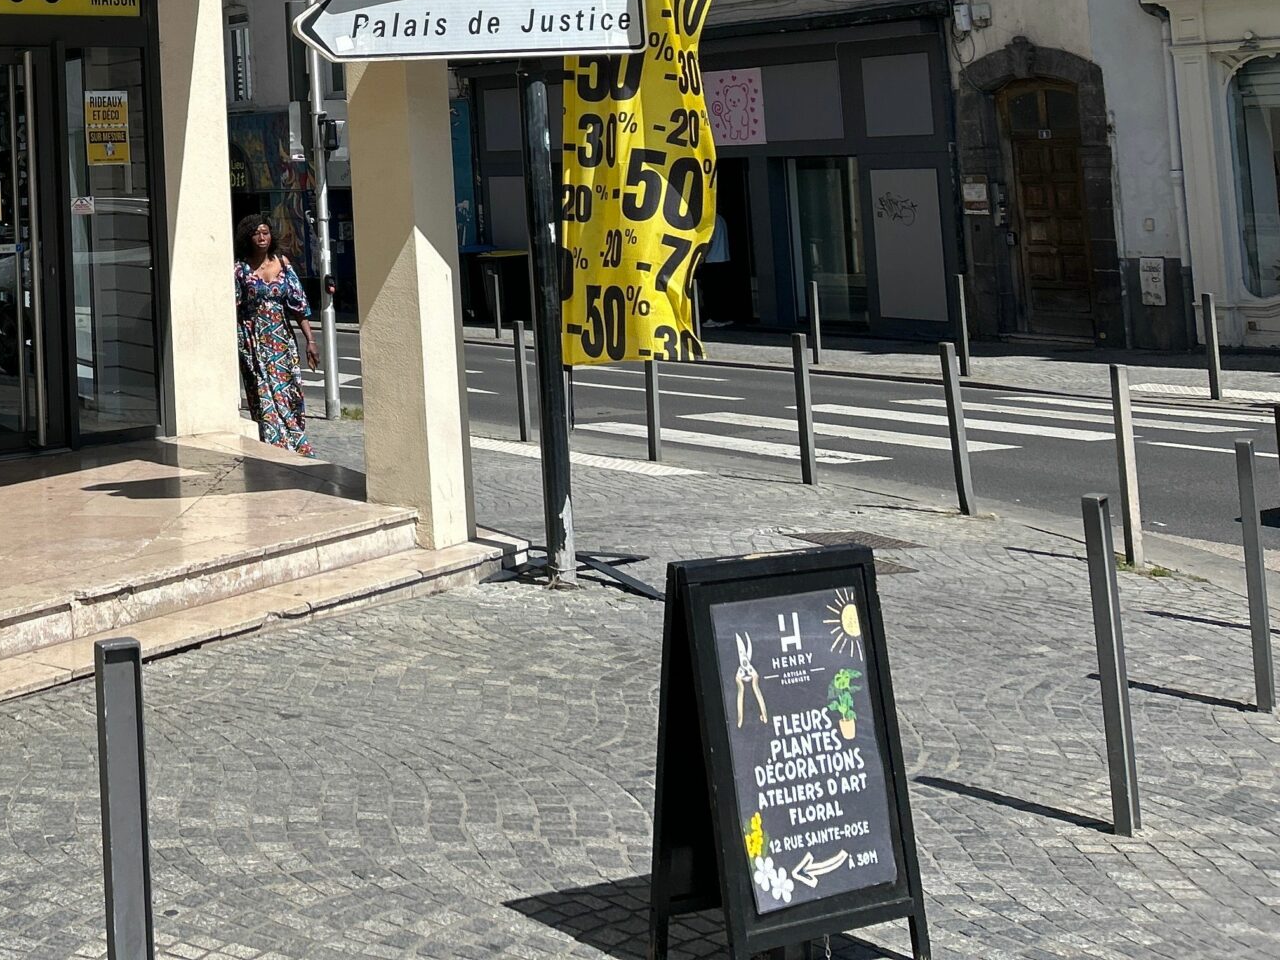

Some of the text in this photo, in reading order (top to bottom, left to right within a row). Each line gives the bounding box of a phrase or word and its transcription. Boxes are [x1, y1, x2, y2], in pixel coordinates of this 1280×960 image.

[352, 7, 631, 38] Palais de Justice
[90, 96, 123, 108] RIDEAUX
[93, 108, 119, 120] ET DÉCO
[90, 133, 102, 142] SUR
[563, 111, 638, 168] -30%
[600, 228, 637, 268] -20%
[567, 285, 650, 361] -50%
[772, 653, 812, 669] HENRY
[783, 670, 807, 678] ARTISAN
[781, 675, 811, 685] FLEURISTE
[772, 707, 832, 736] FLEURS
[770, 728, 842, 761] PLANTES
[754, 747, 865, 787] DÉCORATIONS
[758, 772, 867, 810] ATELIERS D'ART
[789, 800, 844, 825] FLORAL
[770, 821, 870, 854] 12 RUE SAINTE-ROSE
[848, 849, 879, 870] À 30M
